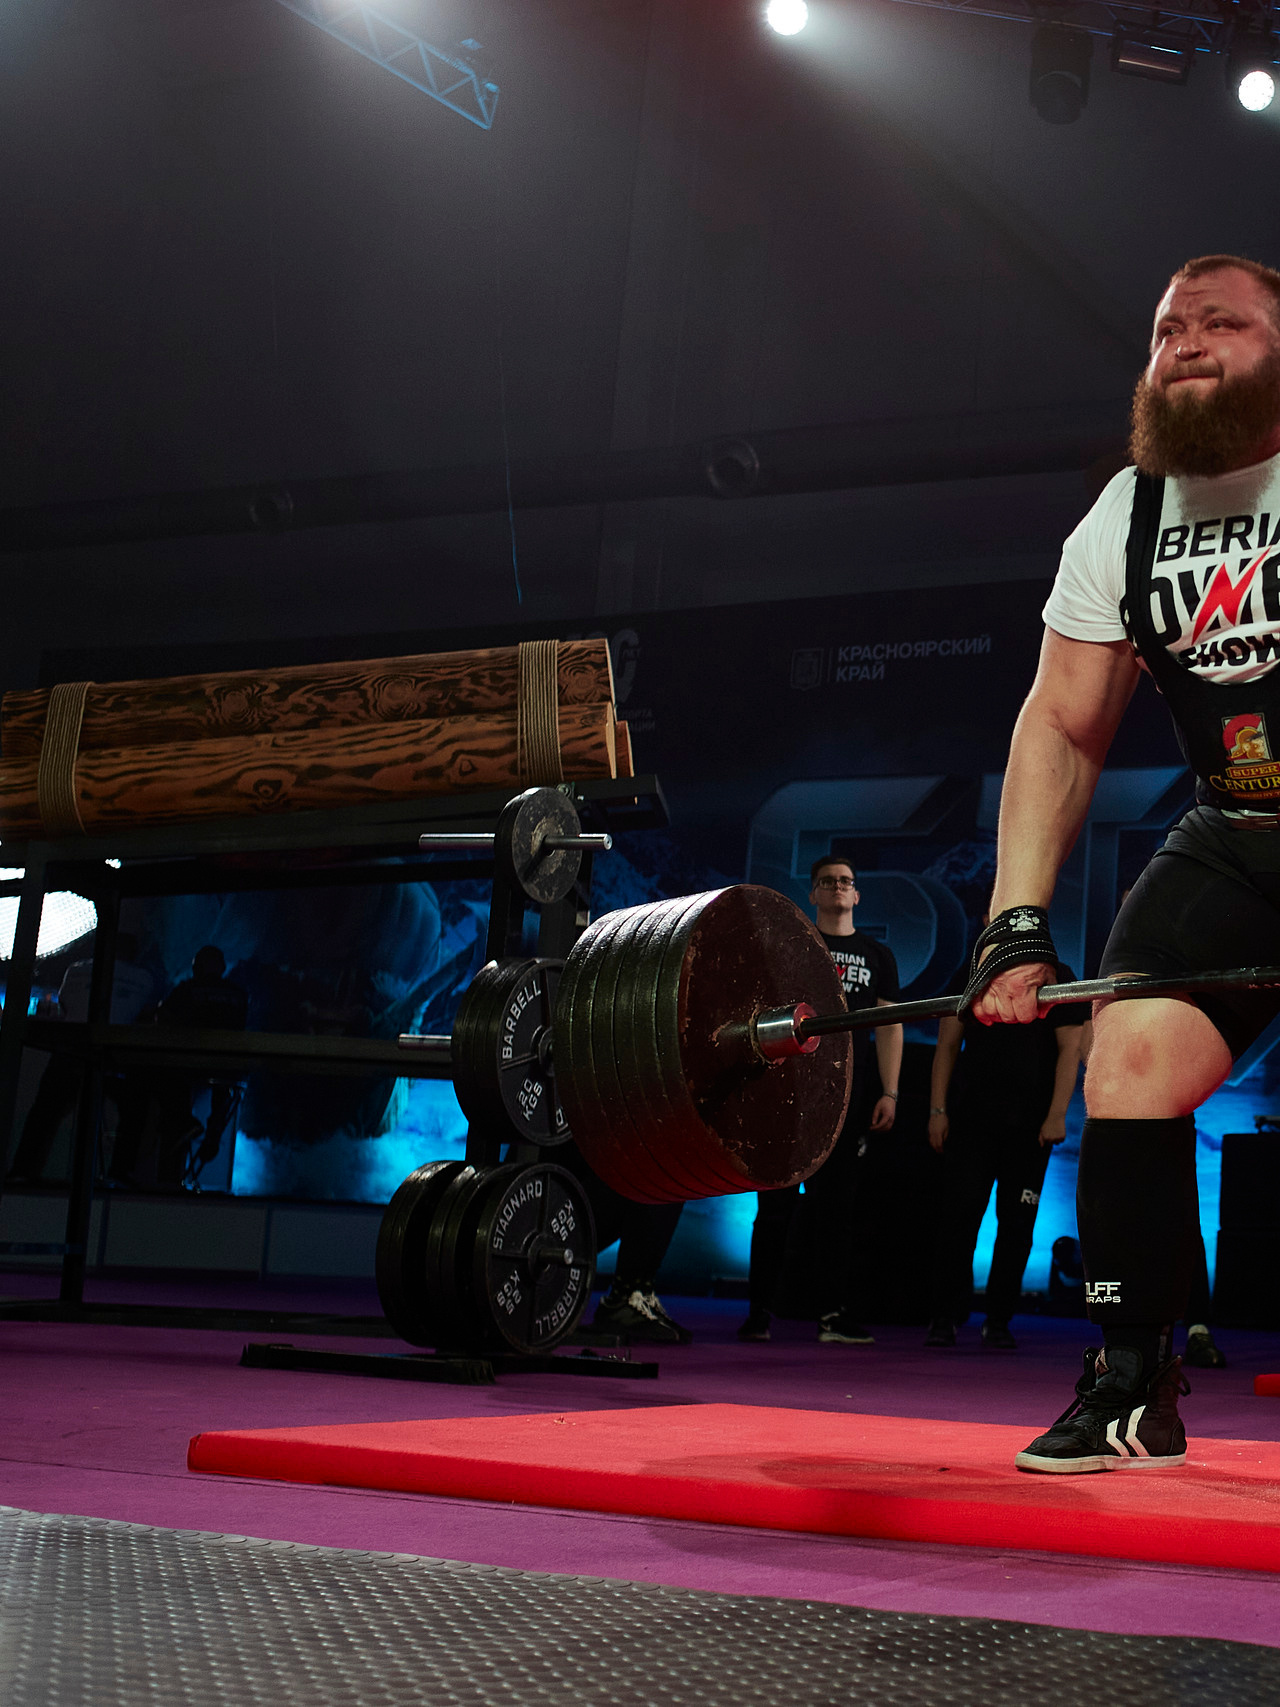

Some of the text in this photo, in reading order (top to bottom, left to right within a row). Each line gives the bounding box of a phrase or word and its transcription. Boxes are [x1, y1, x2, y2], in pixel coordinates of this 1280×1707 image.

[837, 633, 992, 663] КРАСНОЯРСКИЙ
[836, 663, 885, 683] КРАЙ
[1233, 764, 1279, 778] SUPER
[501, 980, 542, 1060] BARBELL
[517, 1078, 534, 1107] 20
[522, 1082, 544, 1122] KGS
[551, 1198, 575, 1235] KGS
[496, 1269, 521, 1308] KGS
[535, 1268, 581, 1336] BARBELL
[1085, 1282, 1122, 1296] UFF
[1086, 1295, 1122, 1304] RAPS
